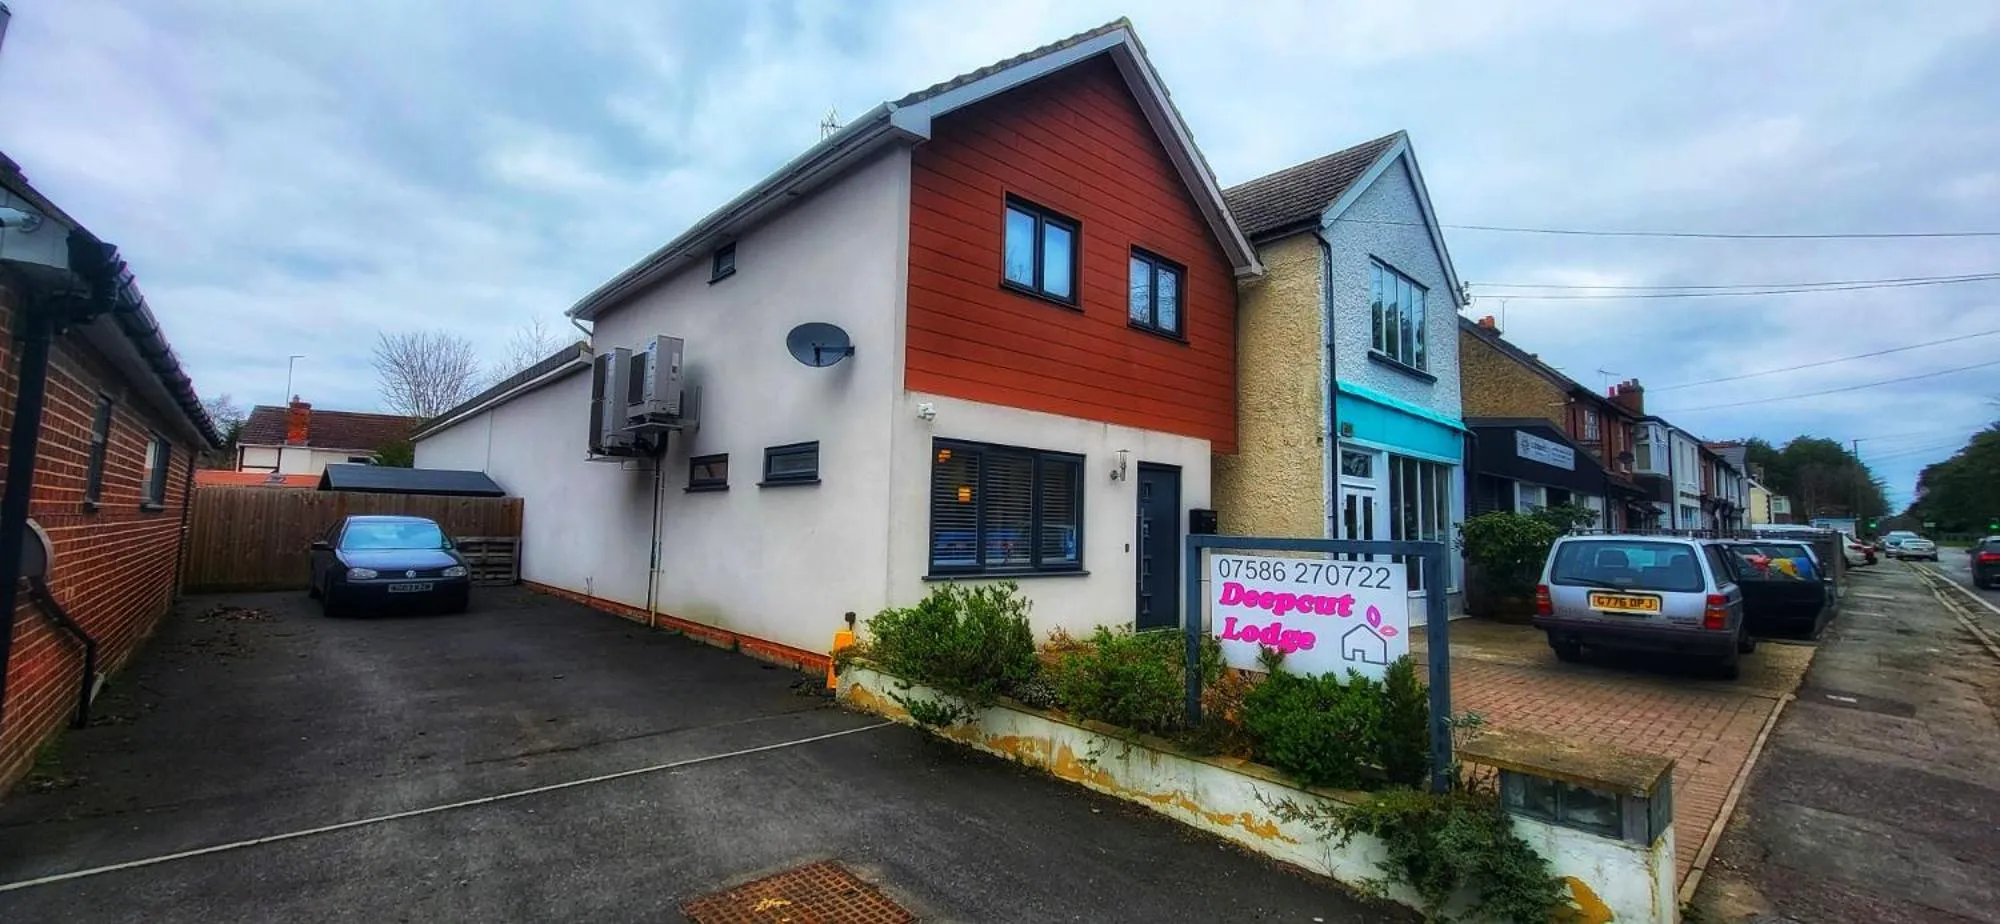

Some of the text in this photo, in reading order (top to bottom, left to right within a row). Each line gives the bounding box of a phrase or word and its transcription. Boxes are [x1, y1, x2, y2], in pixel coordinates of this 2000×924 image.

[1219, 558, 1391, 589] 07586 270722
[1219, 581, 1356, 617] Deepcut
[1222, 616, 1316, 654] Lodge
